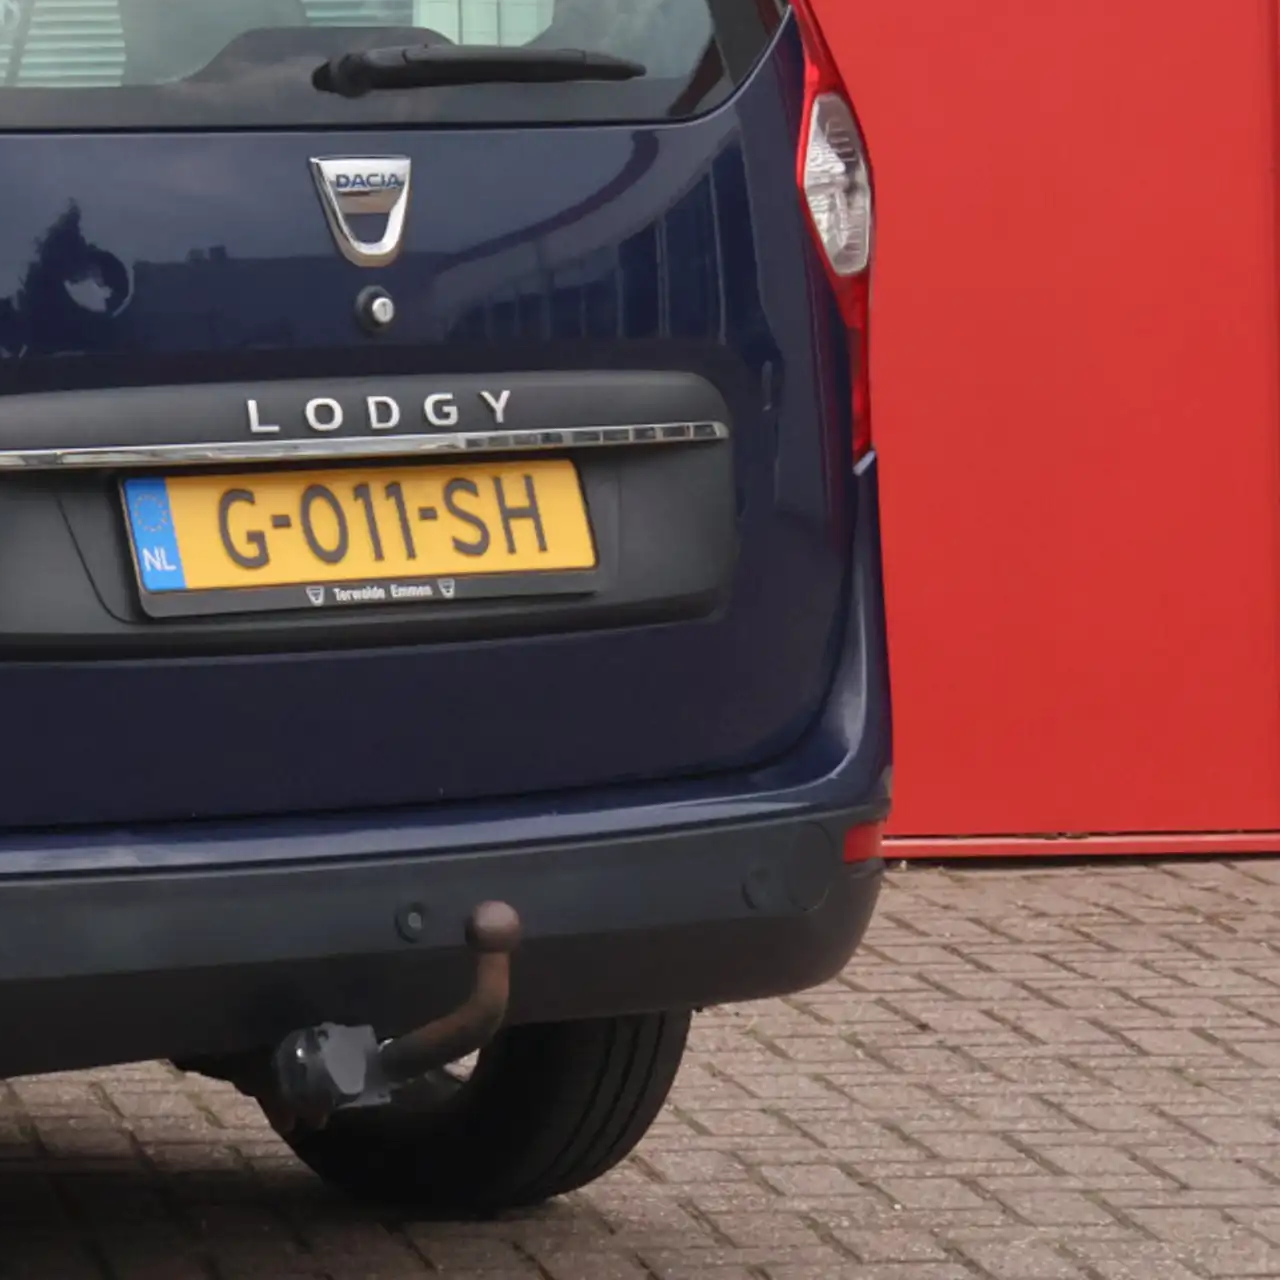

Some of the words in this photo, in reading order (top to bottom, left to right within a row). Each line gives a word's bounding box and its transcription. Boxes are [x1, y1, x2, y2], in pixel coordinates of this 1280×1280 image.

[335, 173, 404, 189] DACIA
[246, 390, 512, 434] LODGY
[217, 473, 549, 570] G-011-SH
[143, 547, 177, 572] NL
